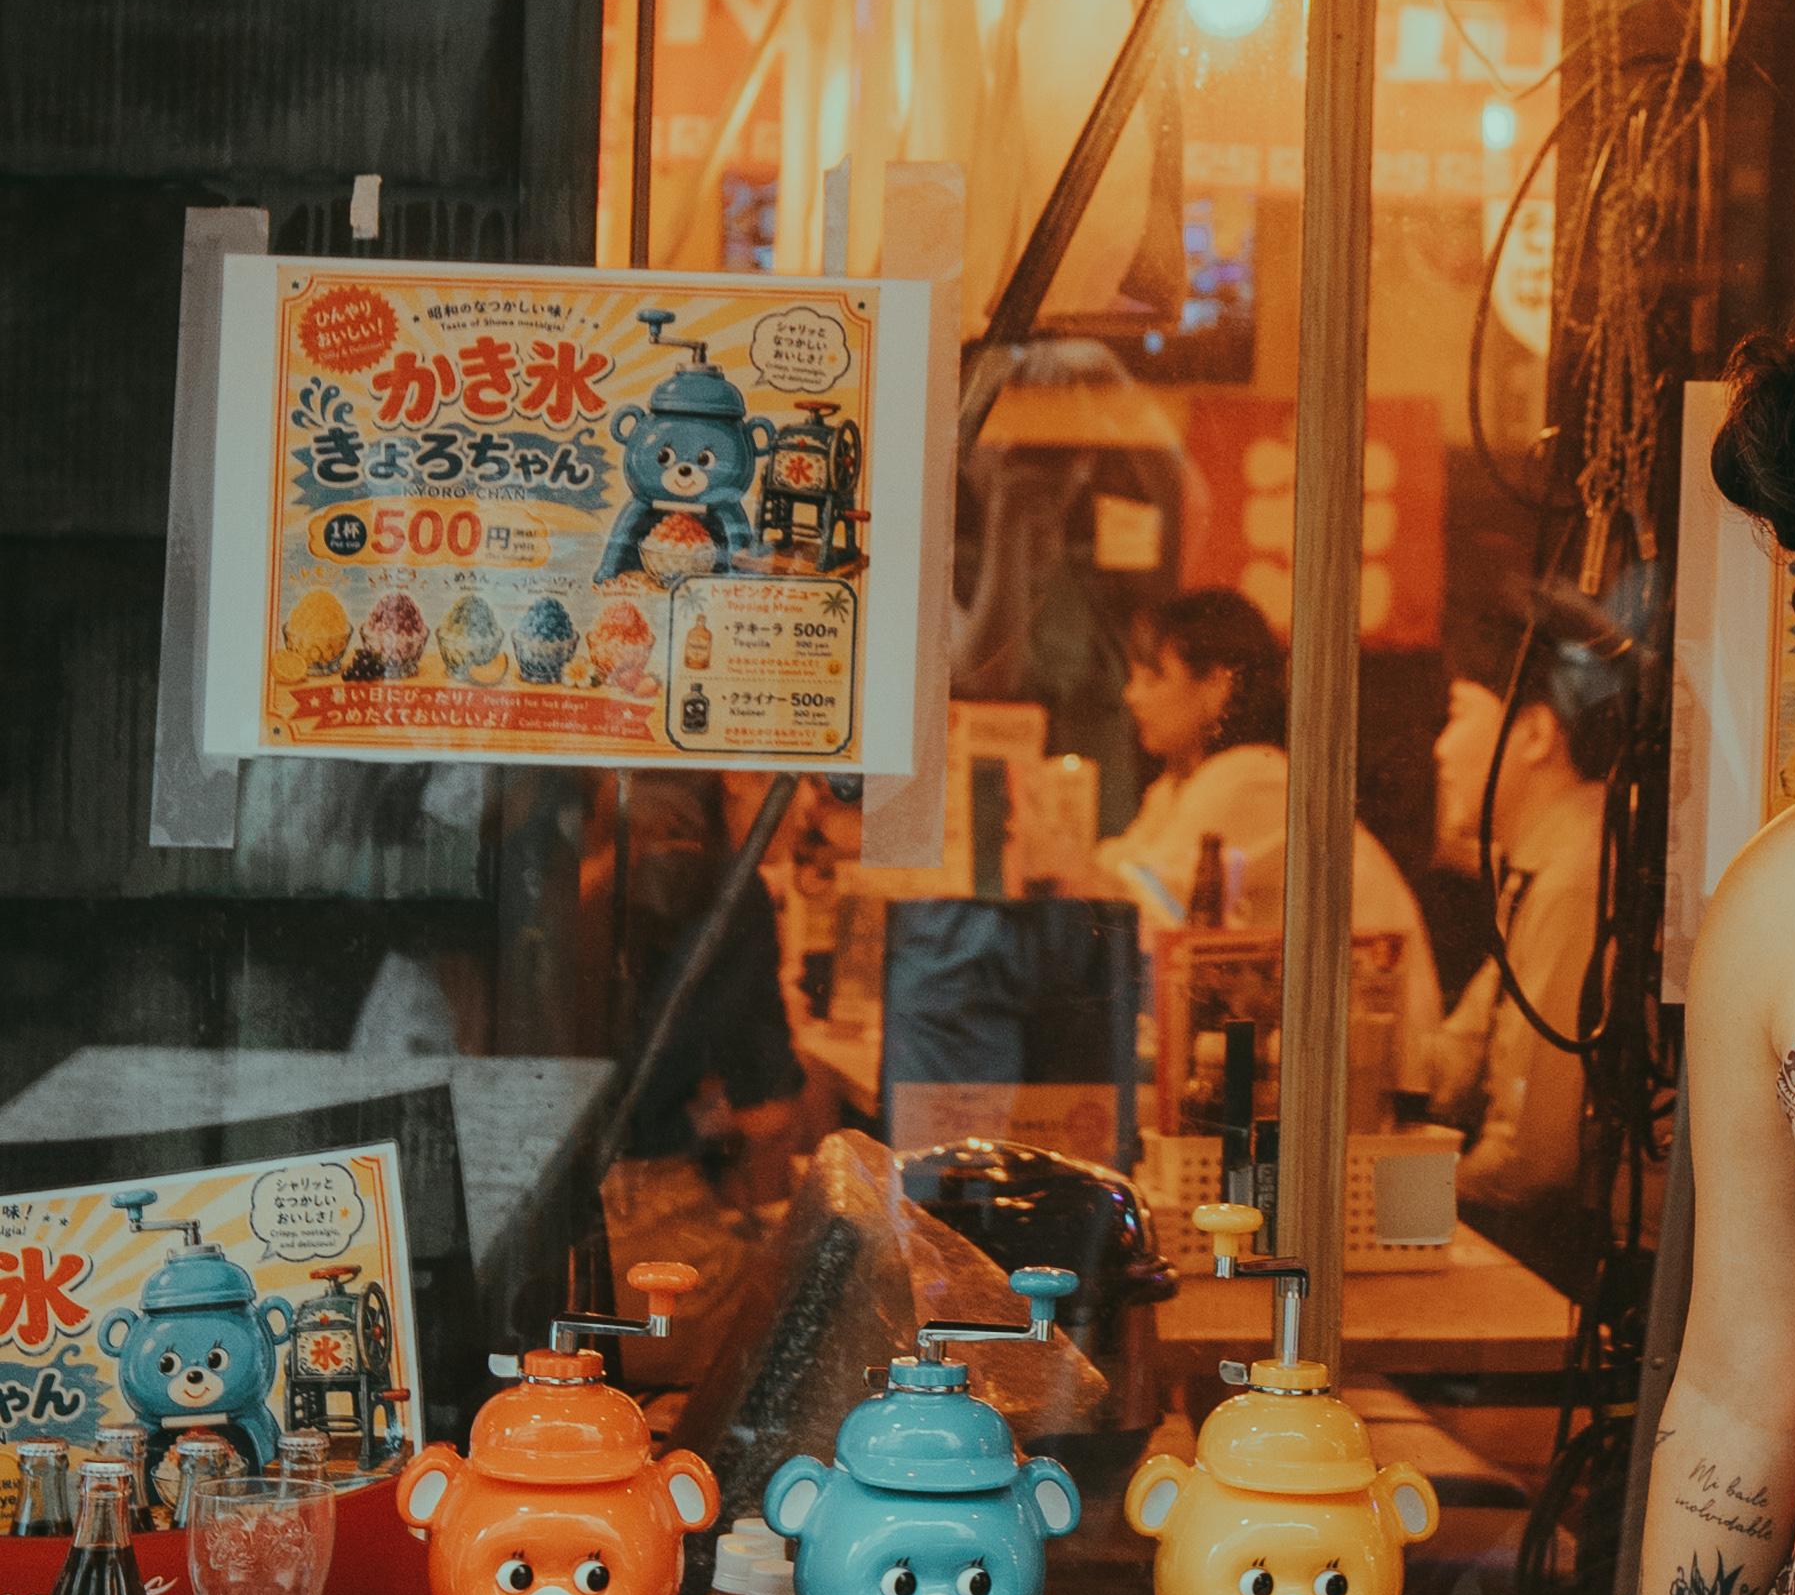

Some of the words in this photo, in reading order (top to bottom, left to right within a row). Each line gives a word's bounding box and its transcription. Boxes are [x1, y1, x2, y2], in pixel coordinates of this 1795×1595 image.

[371, 335, 609, 424] かき氷
[312, 426, 591, 484] きょろちゃん
[785, 455, 813, 485] 氷
[276, 1177, 333, 1192] シャリッと
[274, 1194, 337, 1208] なつかしい
[277, 1209, 335, 1224] おいしさ!
[310, 1335, 343, 1370] 氷
